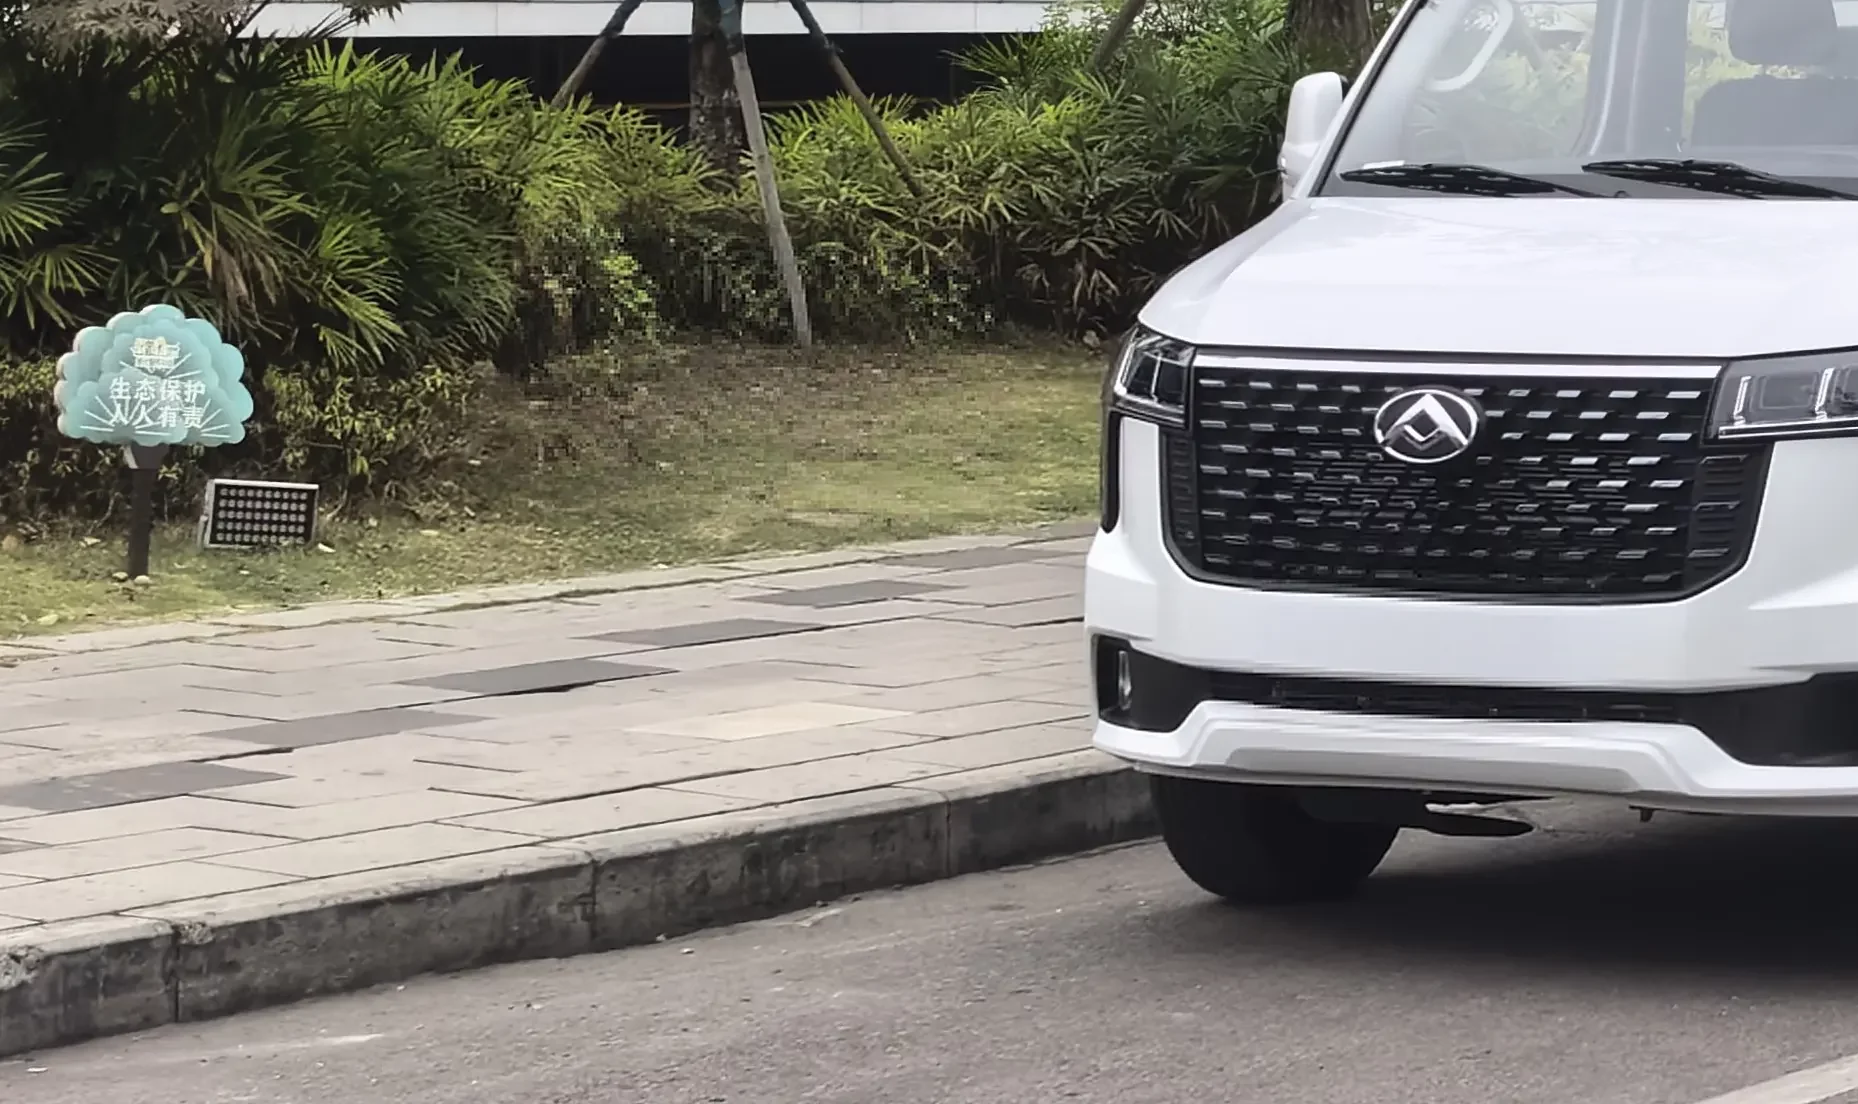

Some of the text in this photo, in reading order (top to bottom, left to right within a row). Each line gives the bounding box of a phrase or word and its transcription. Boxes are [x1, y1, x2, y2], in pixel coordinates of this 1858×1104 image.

[109, 376, 206, 403] 生态保护
[108, 403, 204, 429] 人人有责
